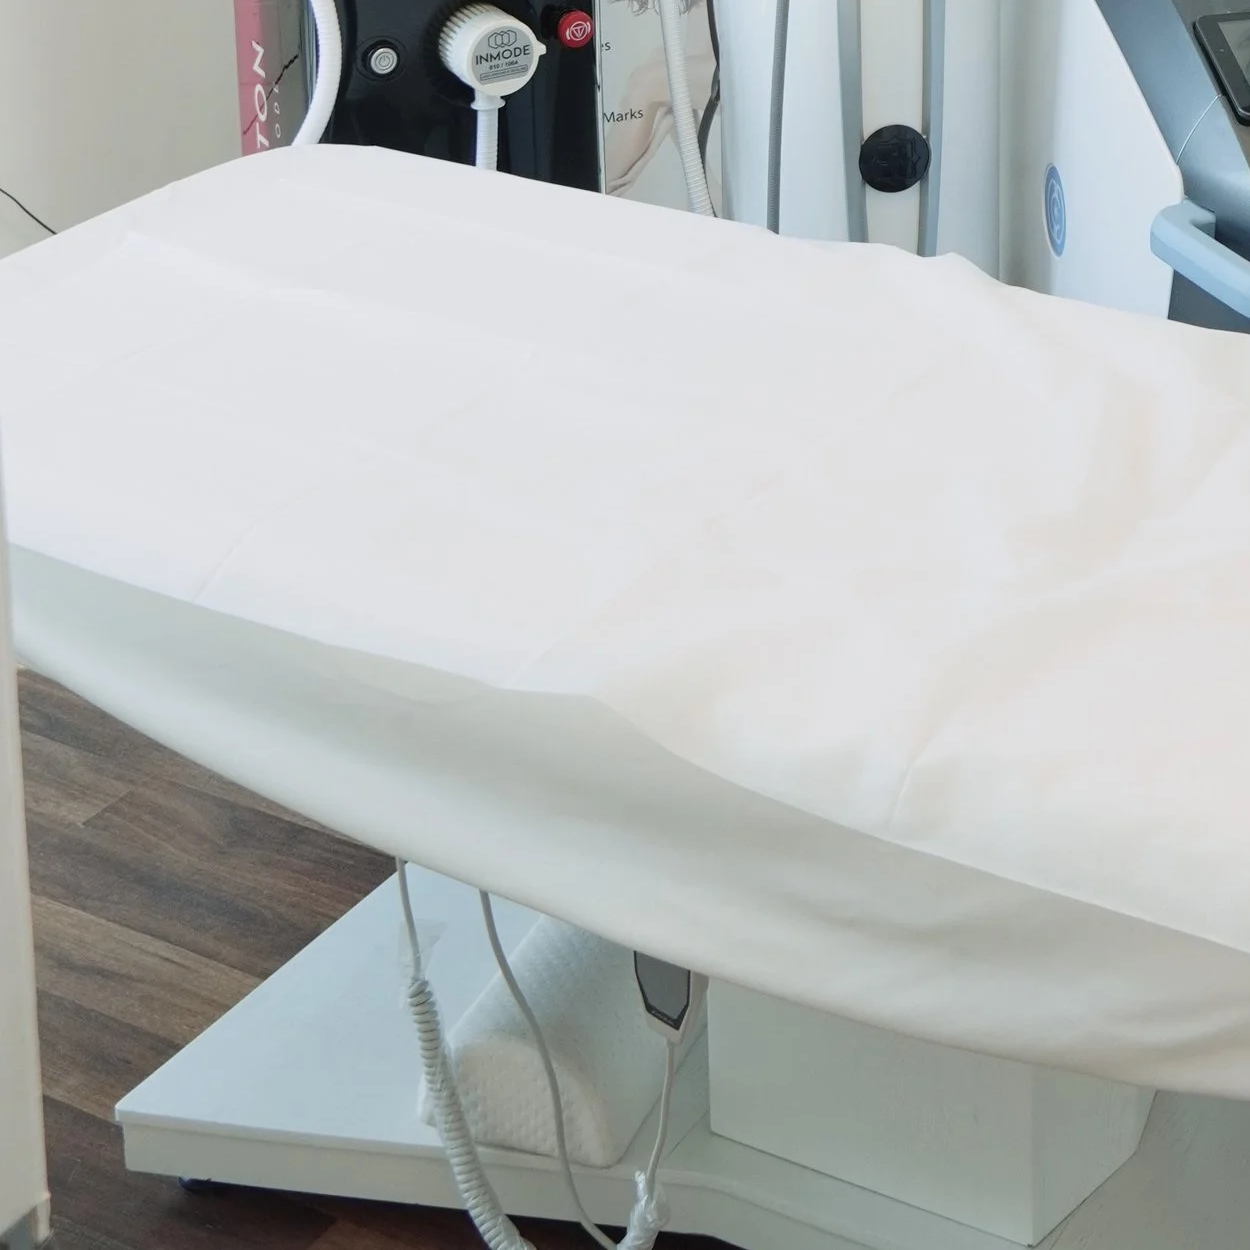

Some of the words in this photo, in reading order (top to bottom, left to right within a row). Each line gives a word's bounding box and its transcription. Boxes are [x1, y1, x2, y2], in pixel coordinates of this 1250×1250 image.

[475, 44, 531, 65] INMODE
[251, 40, 270, 149] TON
[603, 108, 644, 123] Marks
